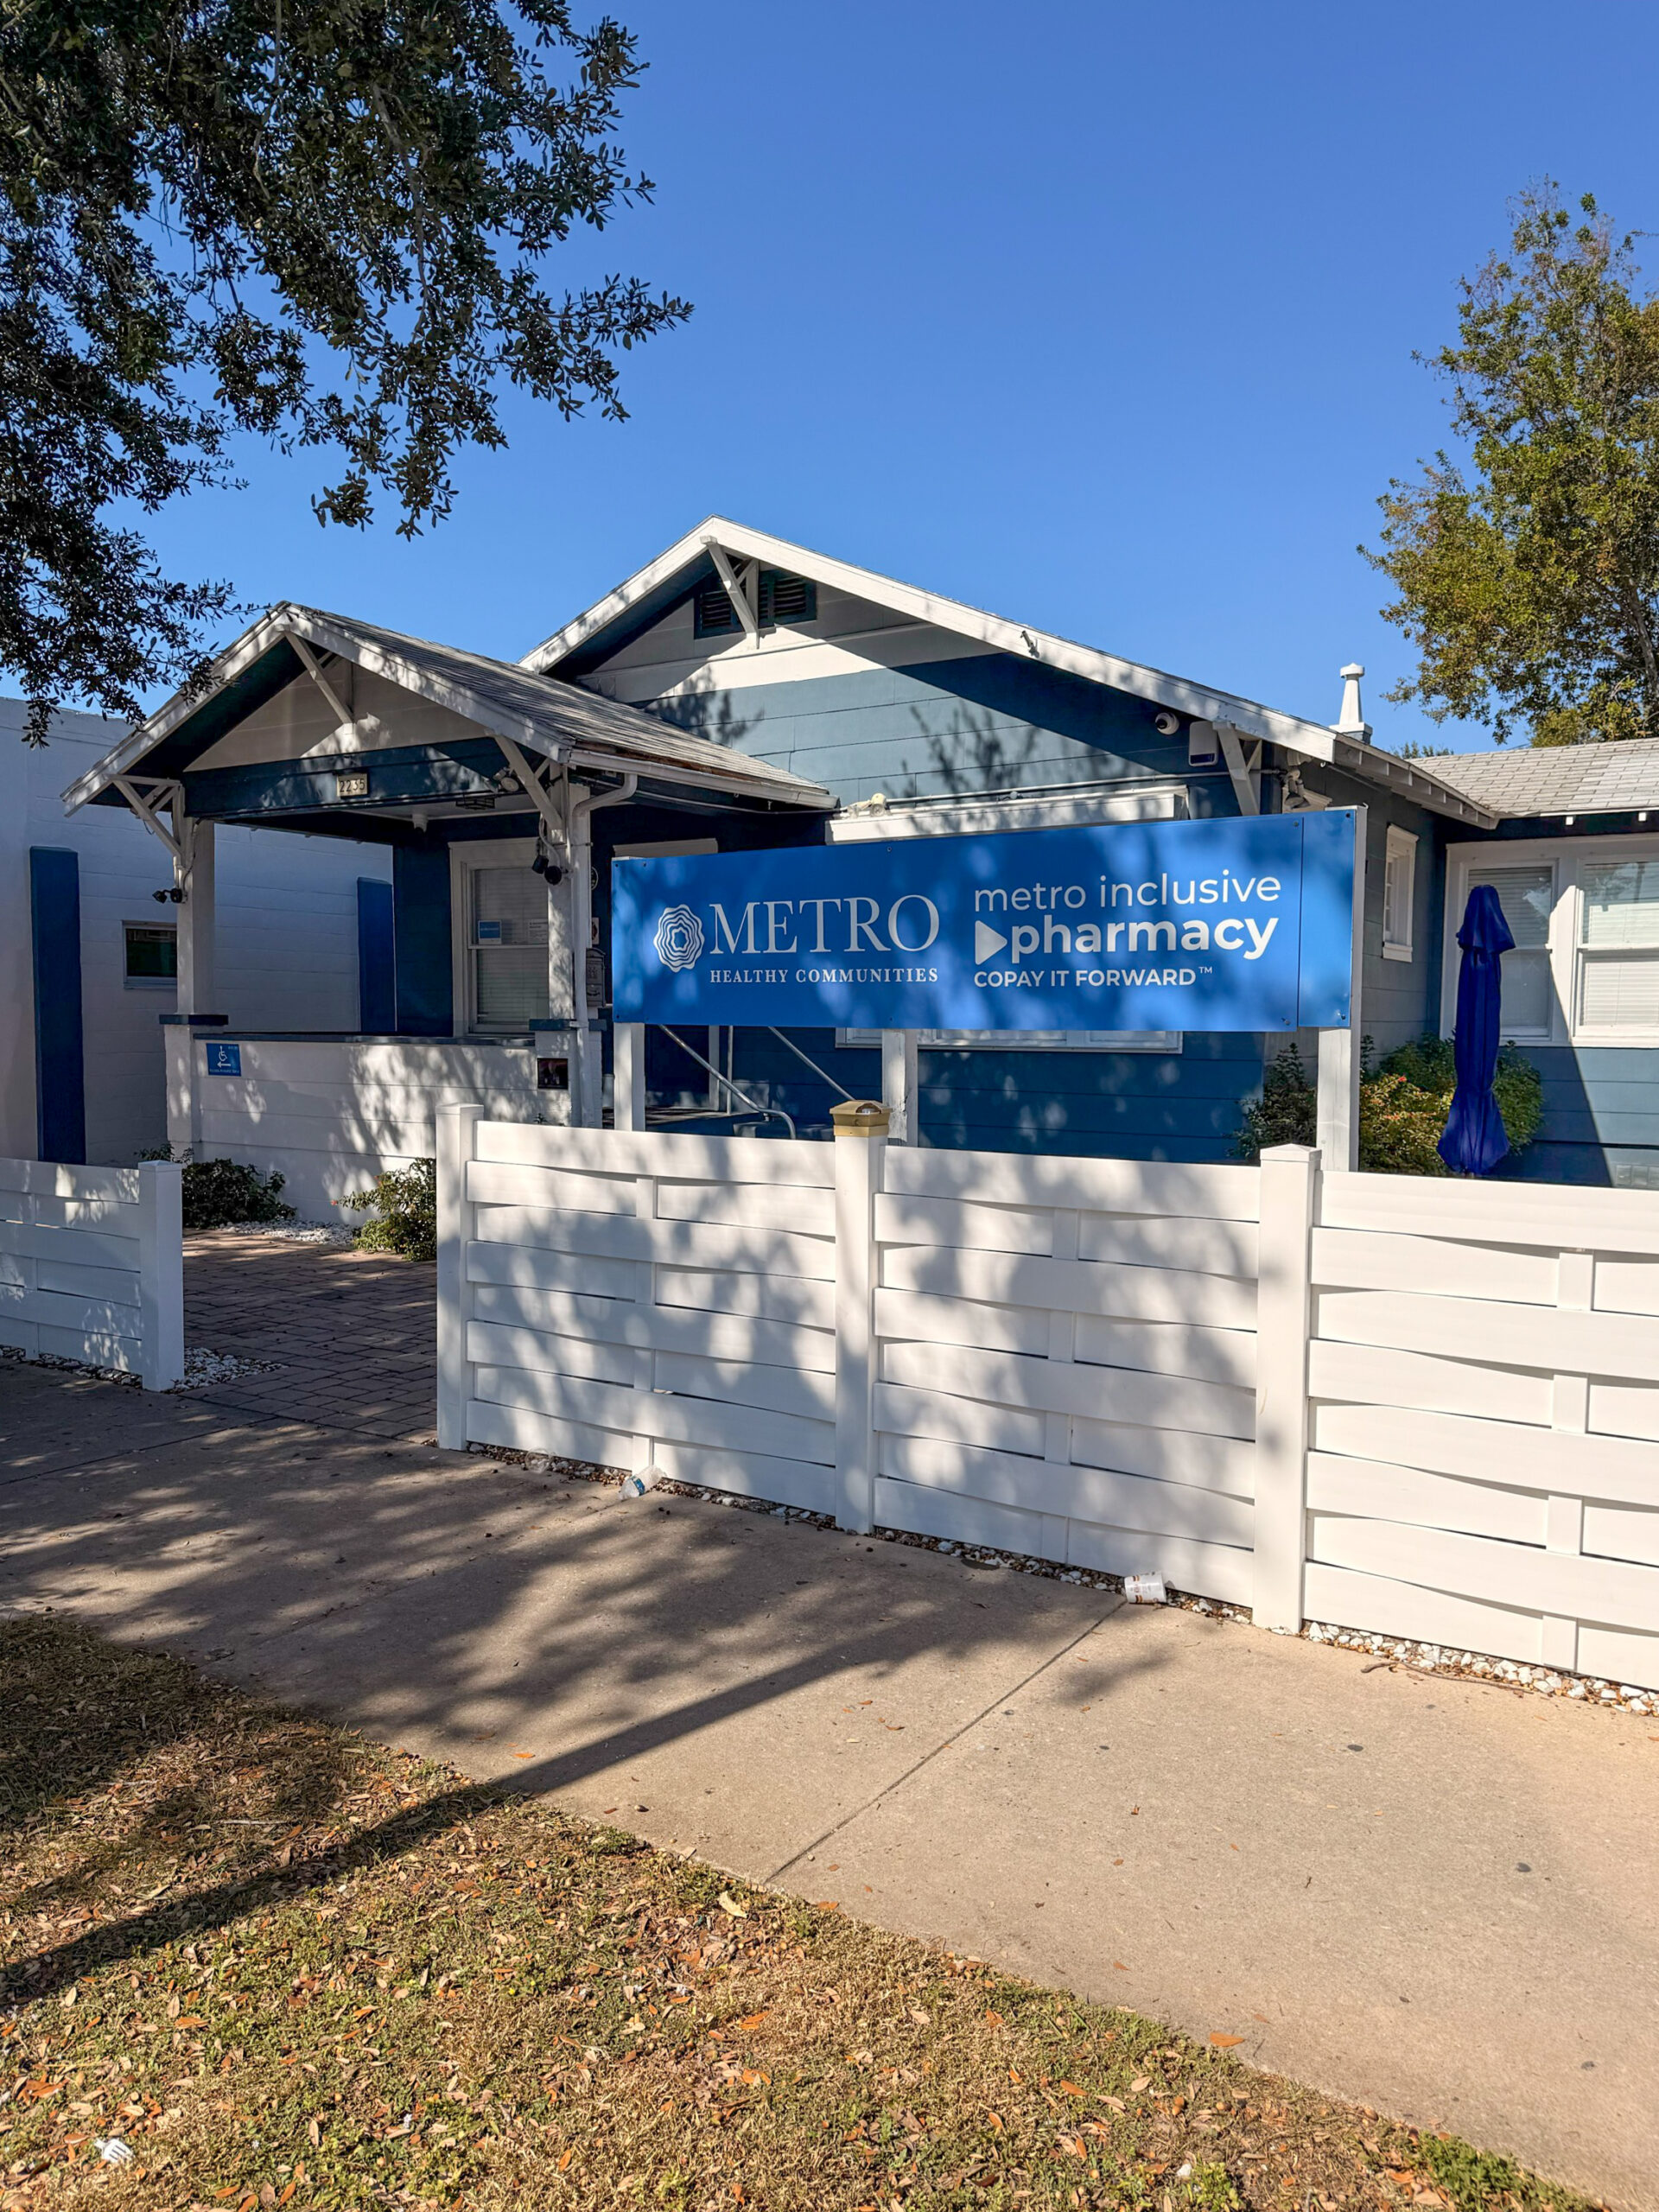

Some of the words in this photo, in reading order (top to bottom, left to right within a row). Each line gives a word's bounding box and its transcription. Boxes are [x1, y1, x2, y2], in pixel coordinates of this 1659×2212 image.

[340, 779, 365, 792] 2235
[975, 883, 1086, 912] metro
[1100, 869, 1281, 907] inclusive
[709, 894, 940, 954] METRO
[1011, 914, 1280, 964] pharmacy
[709, 969, 789, 983] HEALTHY
[796, 968, 939, 982] COMMUNITIES
[974, 970, 1045, 988] COPAY
[1051, 970, 1070, 987] IT
